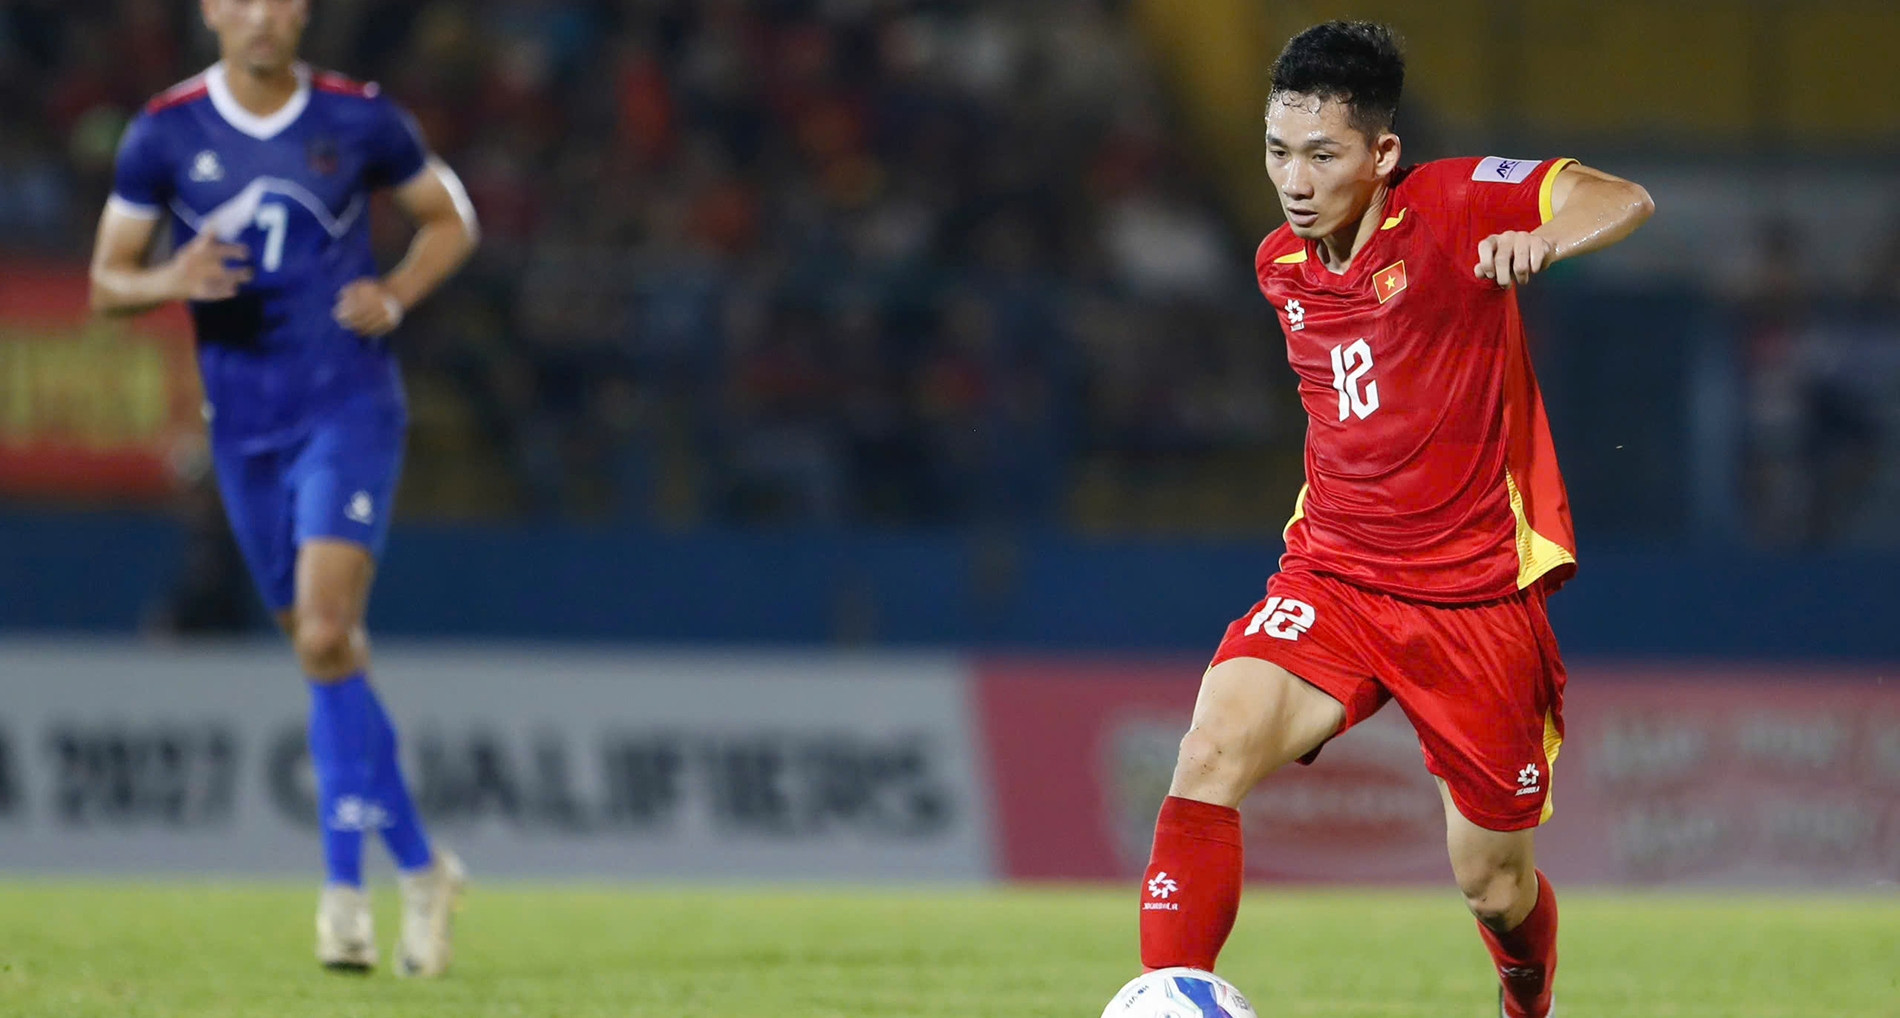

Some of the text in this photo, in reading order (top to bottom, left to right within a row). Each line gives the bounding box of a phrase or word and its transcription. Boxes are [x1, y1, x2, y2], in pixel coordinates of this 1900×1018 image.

[256, 203, 289, 273] 7
[1330, 337, 1380, 422] 12
[1244, 596, 1316, 641] 12
